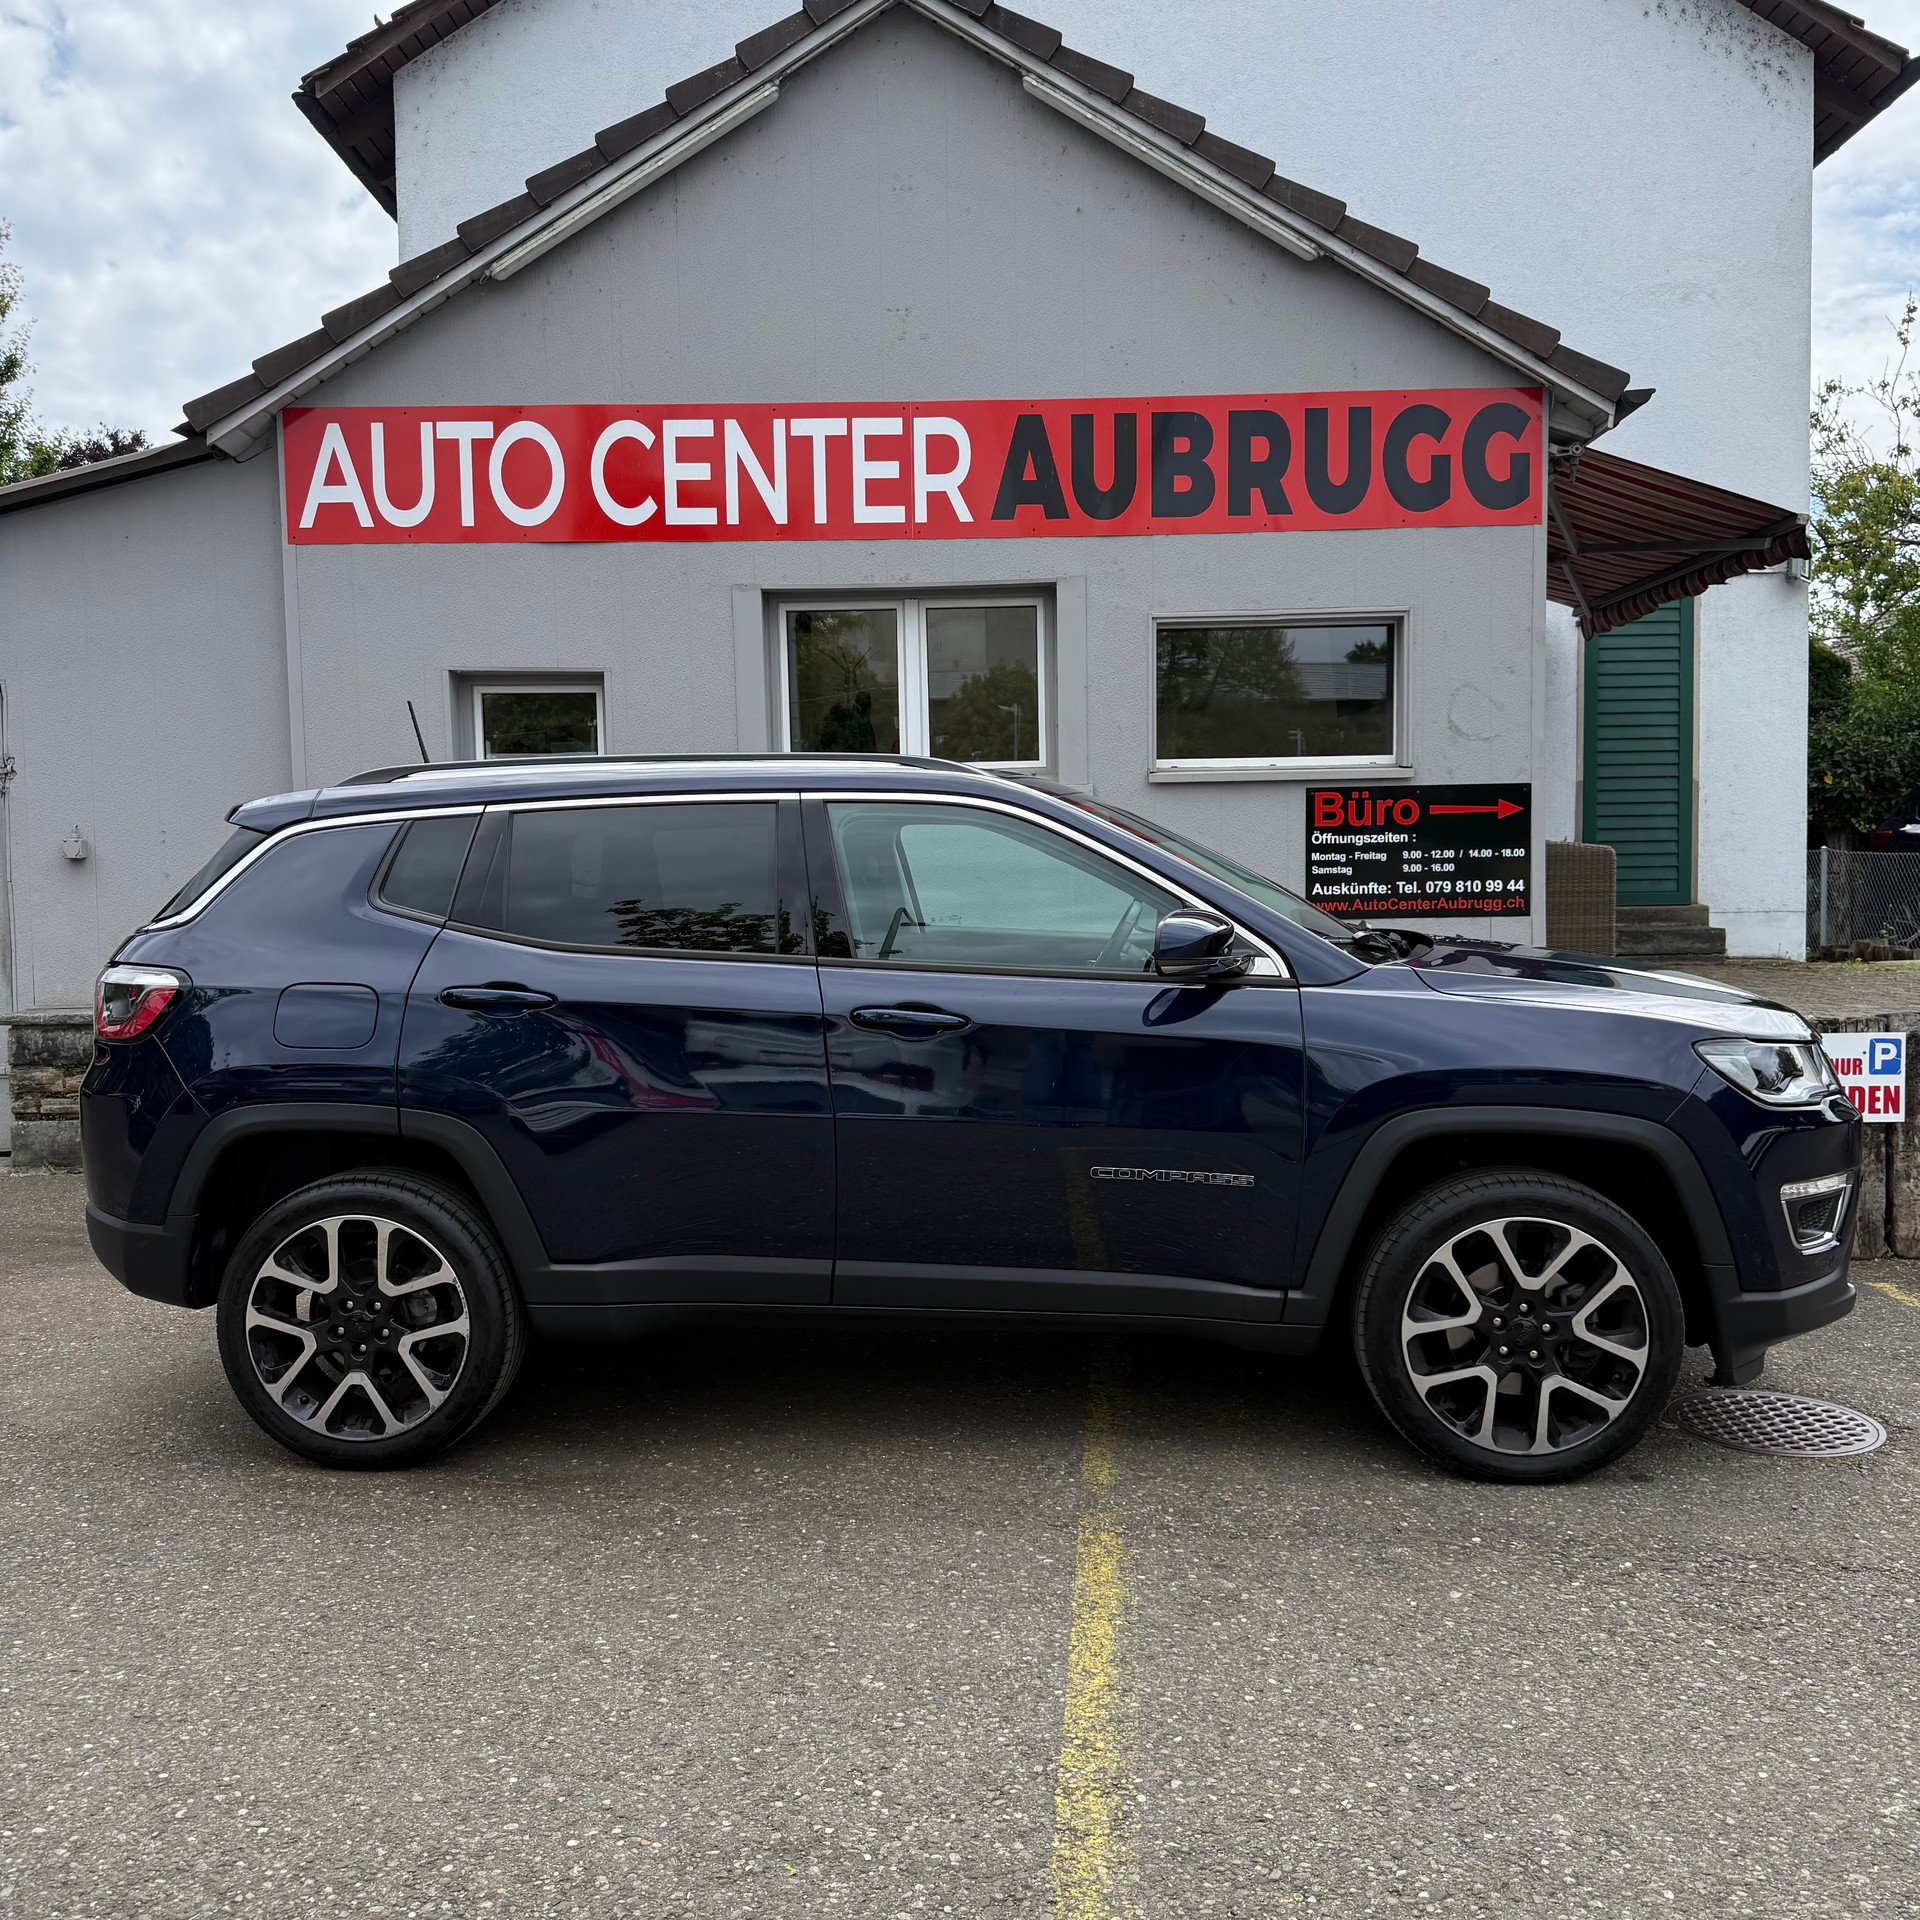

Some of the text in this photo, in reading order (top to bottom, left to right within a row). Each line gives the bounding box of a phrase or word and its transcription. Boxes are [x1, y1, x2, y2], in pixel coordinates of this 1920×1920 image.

[299, 402, 1532, 529] AUTO CENTER AUBRUGG
[1314, 791, 1420, 827] Büro
[1311, 831, 1409, 846] Öffnungszeiten
[1311, 852, 1347, 863] Montag
[1354, 851, 1387, 862] Freitag
[1402, 850, 1422, 859] 9.00
[1430, 849, 1455, 859] 12.00
[1468, 849, 1493, 858] 14.00
[1501, 848, 1525, 857] 18.00
[1311, 865, 1353, 876] Samstag
[1402, 864, 1422, 873] 9.00
[1430, 863, 1455, 872] 16.00
[1311, 879, 1526, 896] Auskünfte: Tel. 079 810 99 44
[1829, 1042, 1898, 1076] NUR P
[1842, 1085, 1901, 1115] DEN
[1090, 1166, 1255, 1187] COMPASS
